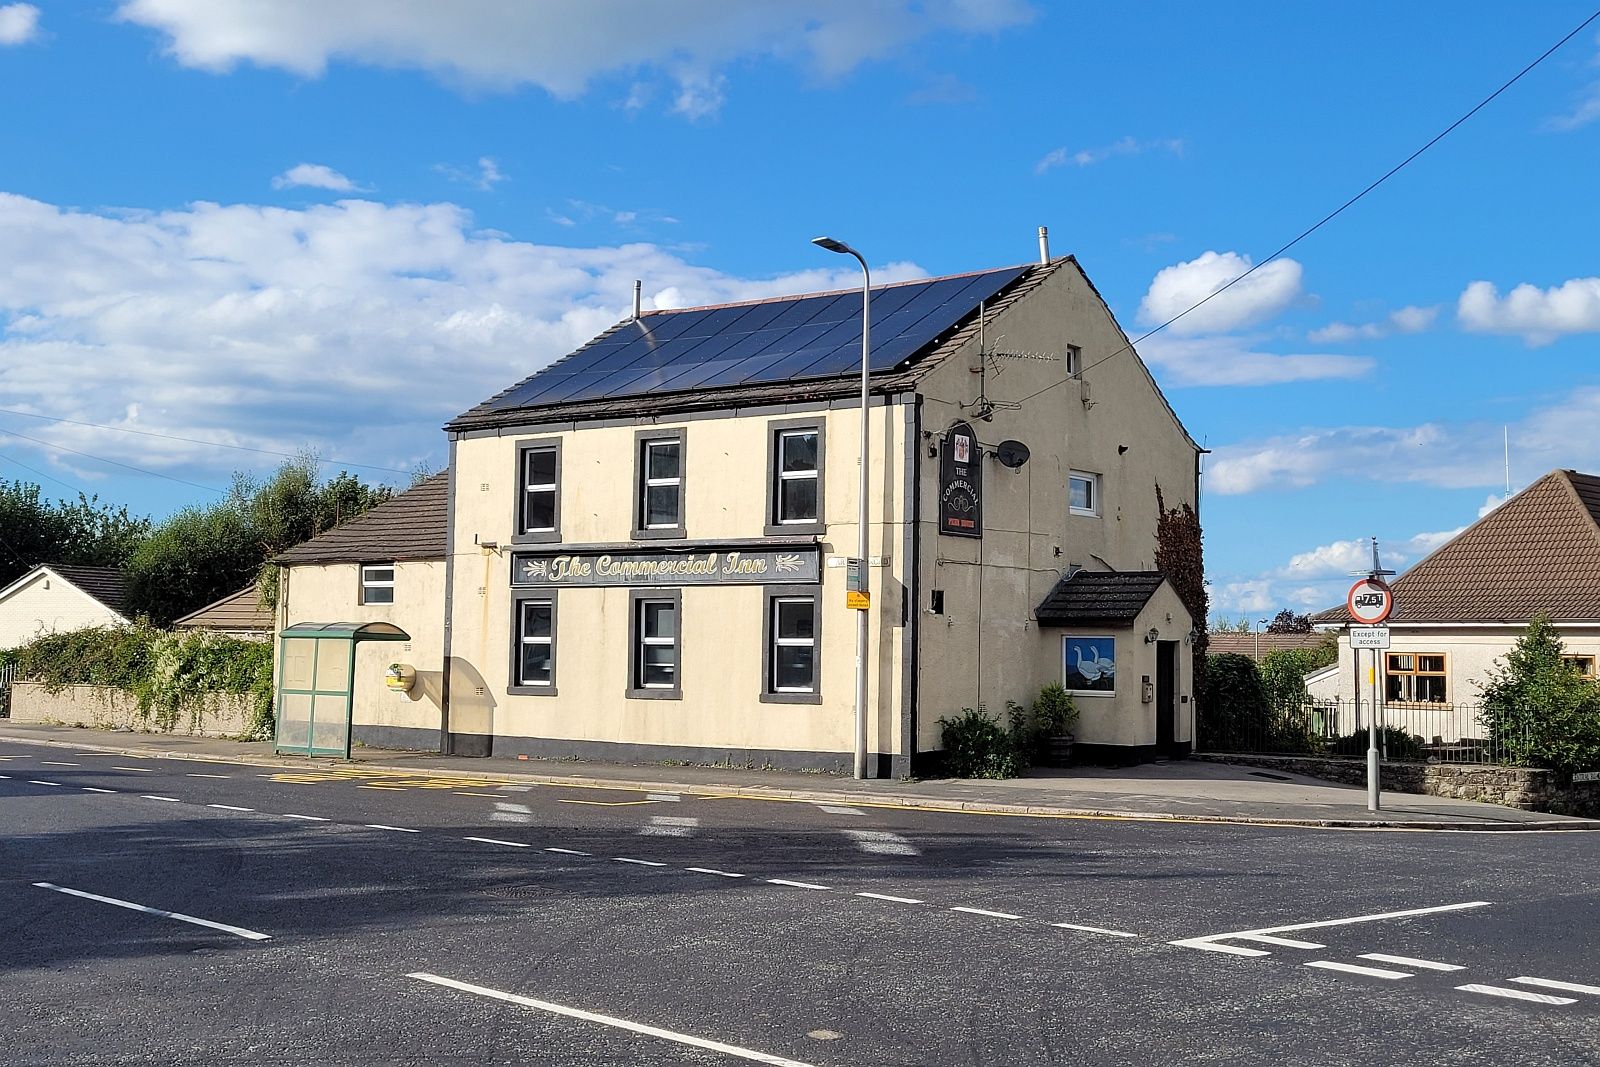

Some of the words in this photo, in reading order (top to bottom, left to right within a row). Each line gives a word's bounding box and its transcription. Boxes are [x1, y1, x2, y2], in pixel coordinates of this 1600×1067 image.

[955, 467, 968, 476] THE
[943, 480, 979, 505] COMMERCIAL
[548, 555, 592, 581] The
[595, 552, 718, 576] Commercial
[722, 552, 768, 575] Inn
